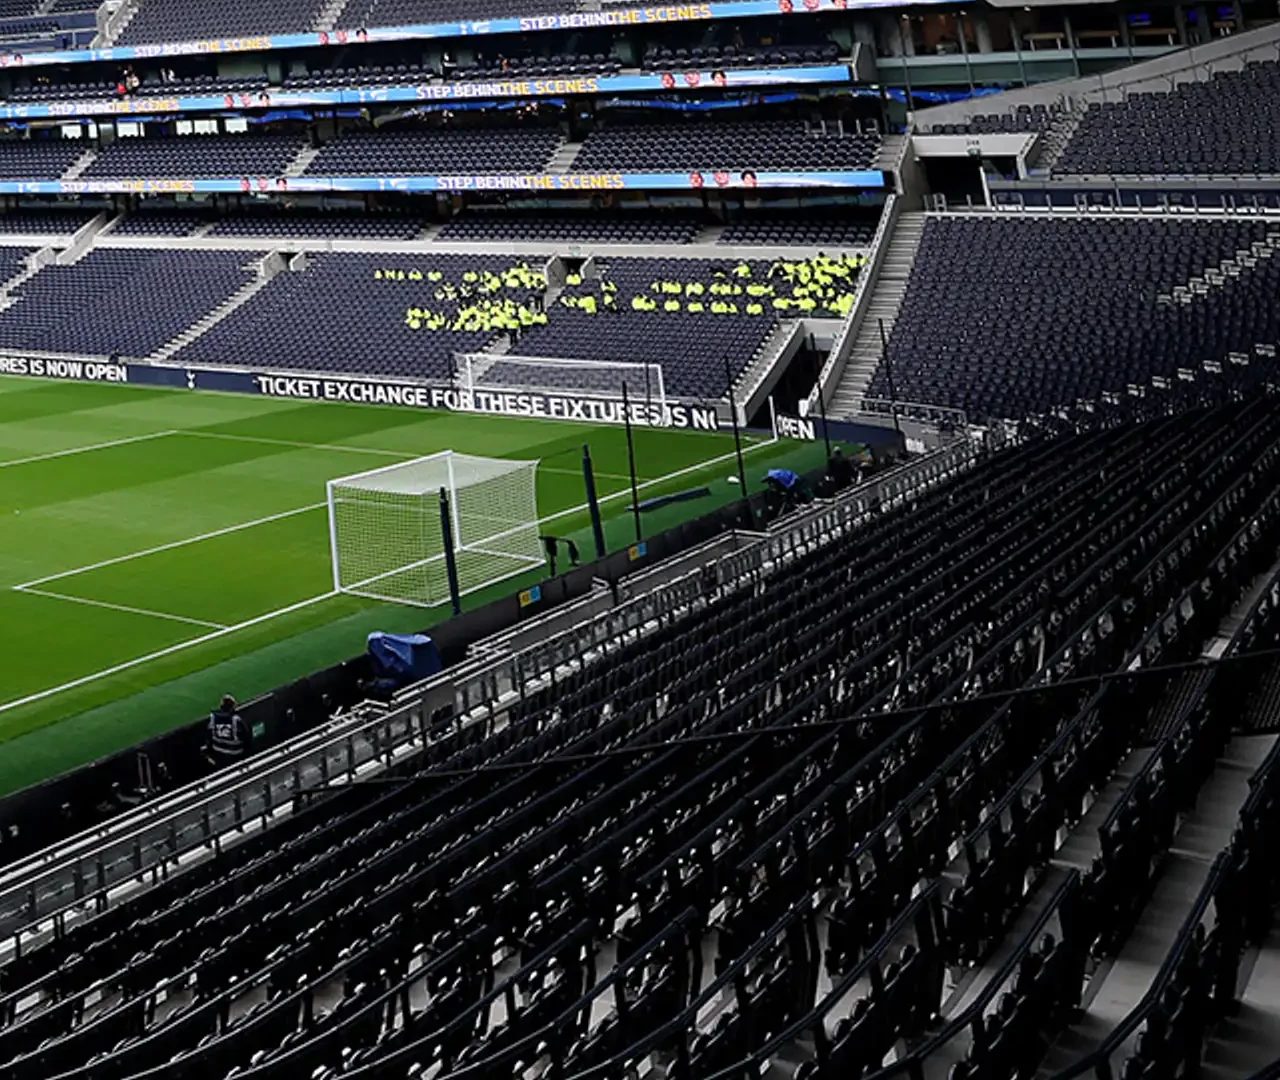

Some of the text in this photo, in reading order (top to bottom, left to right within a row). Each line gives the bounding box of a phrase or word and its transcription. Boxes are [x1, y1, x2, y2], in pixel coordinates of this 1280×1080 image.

[521, 16, 556, 31] STEP
[646, 4, 712, 22] SCENES
[416, 86, 450, 99] STEP
[536, 78, 598, 94] SCENES
[438, 176, 472, 189] STEP
[526, 175, 554, 188] THE
[560, 174, 624, 188] SCENES
[30, 360, 45, 375] IS
[46, 361, 82, 378] NOW
[85, 364, 127, 381] OPEN
[258, 376, 321, 397] TICKET
[324, 382, 429, 406] EXCHANGE
[431, 390, 474, 411] FOR
[474, 392, 544, 414] THESE
[550, 397, 661, 425] FIXTURES
[664, 405, 687, 427] IS
[776, 414, 814, 440] OPEN
